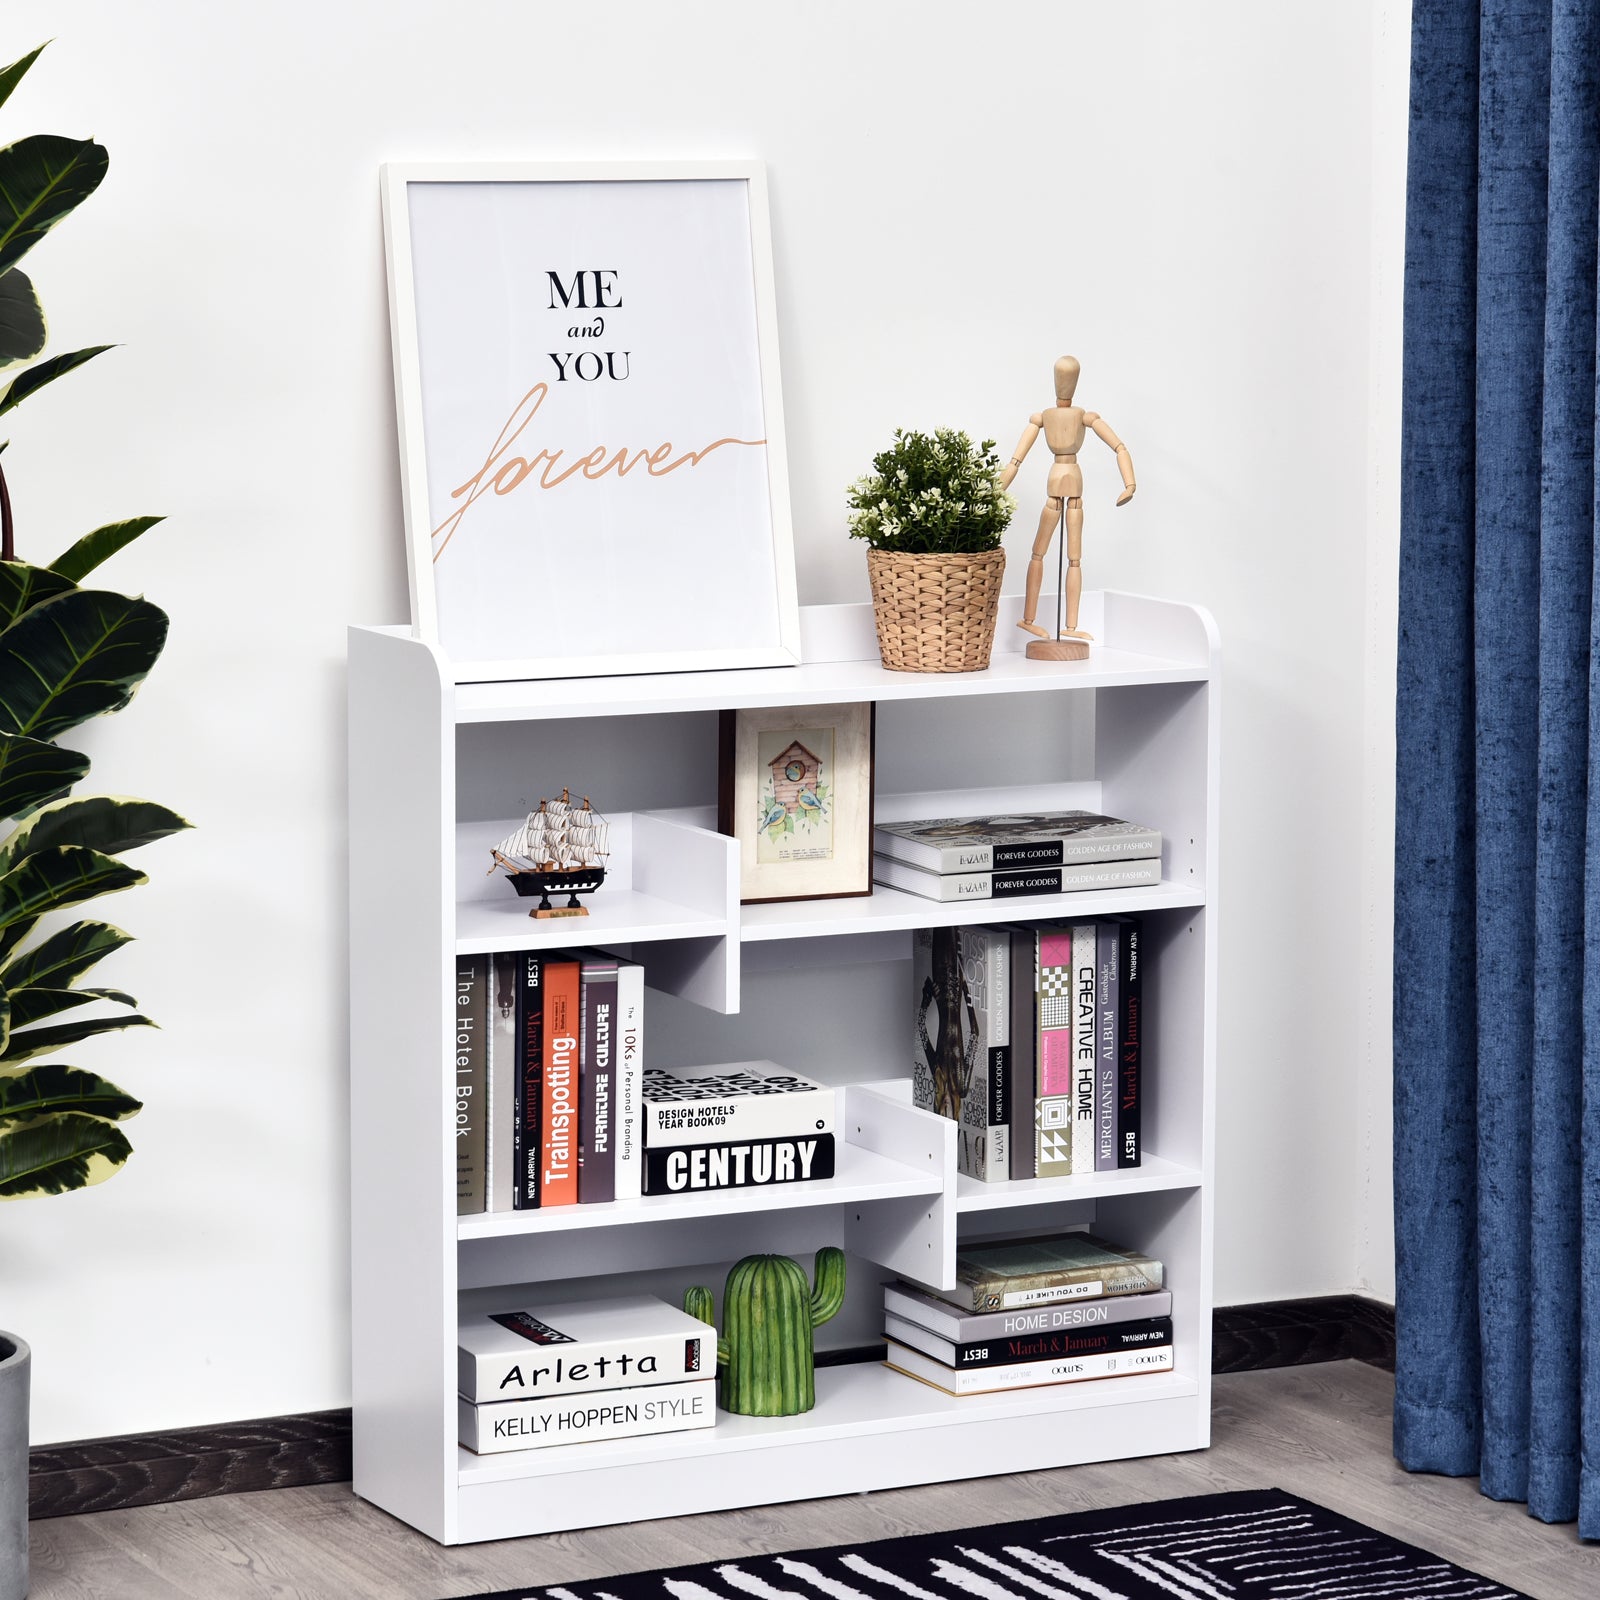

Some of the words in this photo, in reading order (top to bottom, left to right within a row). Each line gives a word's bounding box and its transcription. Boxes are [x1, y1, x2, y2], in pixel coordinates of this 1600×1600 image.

[544, 270, 623, 310] ME
[567, 317, 604, 339] and
[547, 351, 631, 382] YOU
[431, 382, 767, 563] forever
[996, 851, 1026, 860] FOREVER
[1028, 849, 1059, 859] GODDESS
[1068, 845, 1096, 856] GOLDEN
[1098, 844, 1111, 852] AGE
[1112, 844, 1122, 852] OF
[1123, 842, 1152, 850] FASHION
[996, 879, 1024, 889] FOREVER
[1026, 877, 1058, 887] GODDESS
[1066, 874, 1094, 885] GOLDEN
[1111, 872, 1122, 880] OF
[1122, 870, 1152, 880] FASHION
[458, 967, 474, 1006] The
[528, 957, 538, 987] BEST
[996, 980, 1003, 990] OF
[1078, 967, 1094, 1059] CREATIVE
[1123, 995, 1140, 1049] January
[457, 1017, 473, 1073] Hotel
[527, 1011, 542, 1059] March
[597, 1004, 609, 1067] CULTURE
[624, 1027, 637, 1060] 10Ks
[1102, 1010, 1113, 1060] ALBUM
[528, 1062, 540, 1076] &
[1126, 1054, 1136, 1069] &
[525, 1078, 542, 1132] January
[624, 1072, 634, 1115] Personal
[1078, 1068, 1094, 1121] HOME
[1122, 1072, 1136, 1110] March
[456, 1085, 472, 1137] Book
[545, 1036, 576, 1185] Trainspotting
[658, 1109, 694, 1120] DESIGN
[698, 1105, 735, 1117] HOTELS
[658, 1119, 683, 1130] YEAR
[1101, 1070, 1113, 1160] MERCHANTS
[622, 1118, 633, 1160] Branding
[1125, 1132, 1135, 1161] BEST
[666, 1140, 817, 1191] CENTURY
[1036, 1291, 1054, 1299] LIKE
[1056, 1288, 1073, 1296] YOU
[1004, 1312, 1048, 1332] HOME
[1121, 1332, 1148, 1343] ARRIVAL
[1148, 1331, 1164, 1340] NEW
[963, 1347, 988, 1361] BEST
[1008, 1339, 1046, 1356] March
[1050, 1336, 1060, 1352] &
[1062, 1334, 1110, 1353] January
[499, 1354, 657, 1390] Arletta
[494, 1413, 552, 1438] KELLY
[559, 1404, 638, 1430] HOPPEN
[644, 1396, 703, 1420] STYLE
